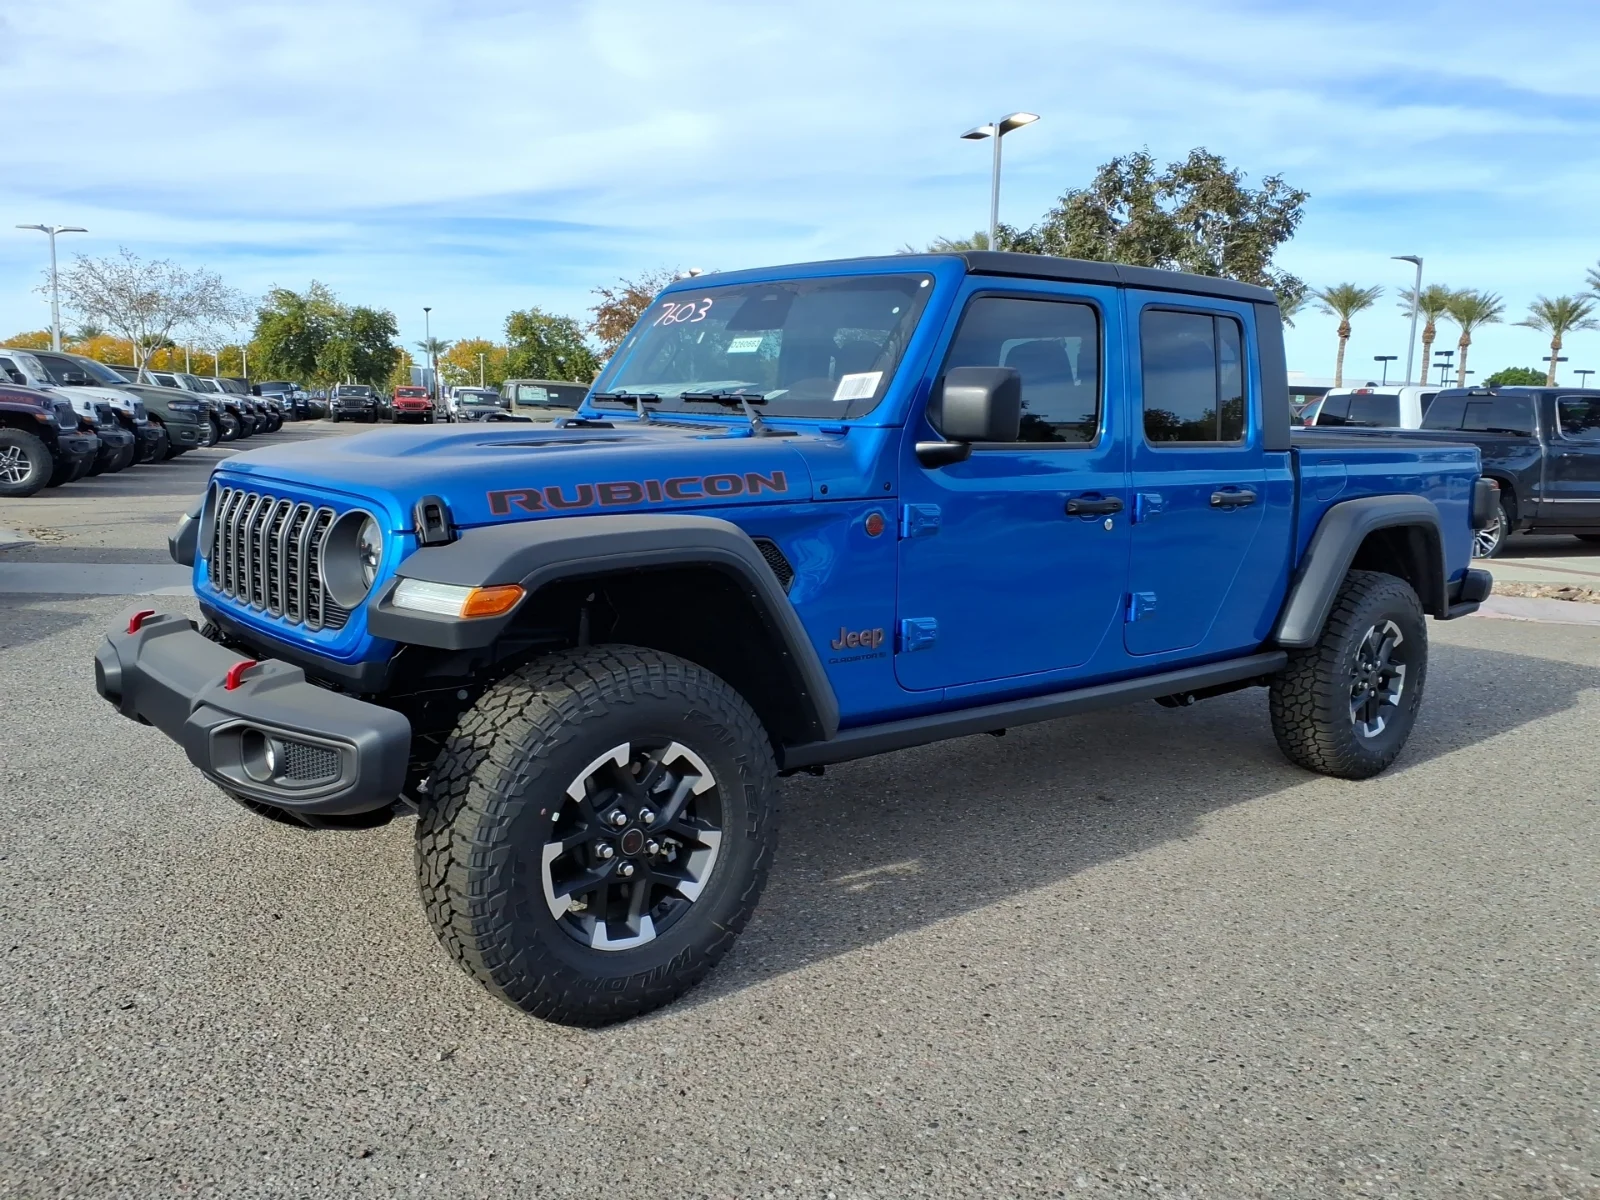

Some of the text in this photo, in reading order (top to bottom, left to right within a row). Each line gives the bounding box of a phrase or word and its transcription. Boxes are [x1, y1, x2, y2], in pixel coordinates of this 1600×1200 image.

[653, 298, 713, 327] 7603
[487, 471, 787, 514] RUBICON
[830, 626, 885, 650] Jeep
[829, 652, 878, 664] GLADIATOR
